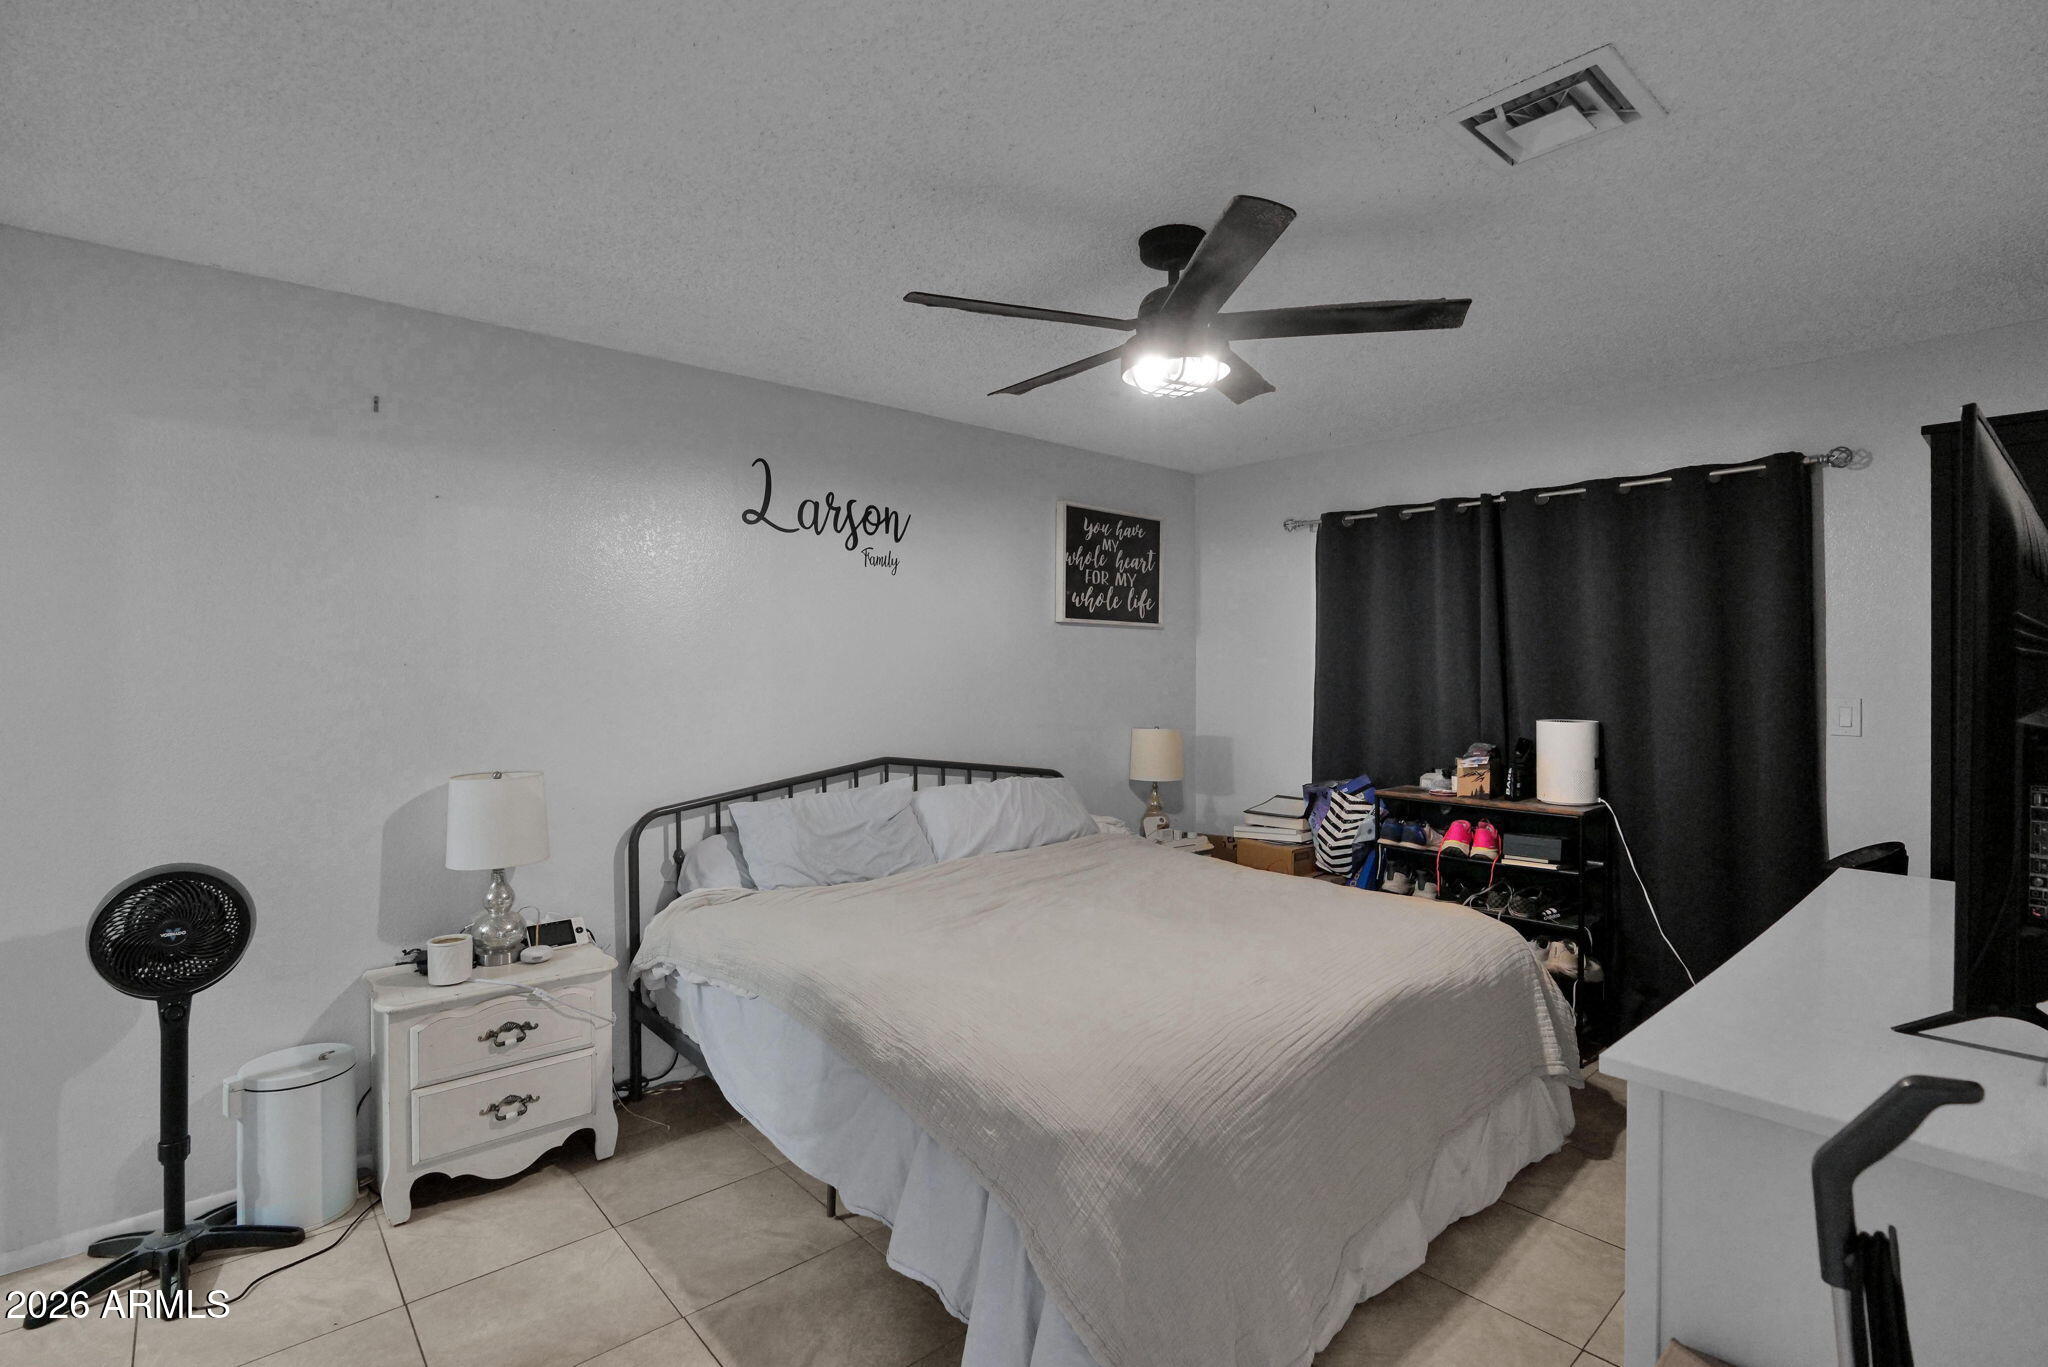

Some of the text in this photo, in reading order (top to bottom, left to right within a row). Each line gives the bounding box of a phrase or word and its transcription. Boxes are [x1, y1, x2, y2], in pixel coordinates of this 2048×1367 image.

[742, 458, 911, 550] Larson
[1083, 516, 1146, 540] you have
[1065, 545, 1157, 573] whole heart
[1102, 538, 1119, 553] MY
[861, 547, 900, 575] Family
[1085, 569, 1137, 587] FOR MY
[1071, 586, 1155, 619] whole life
